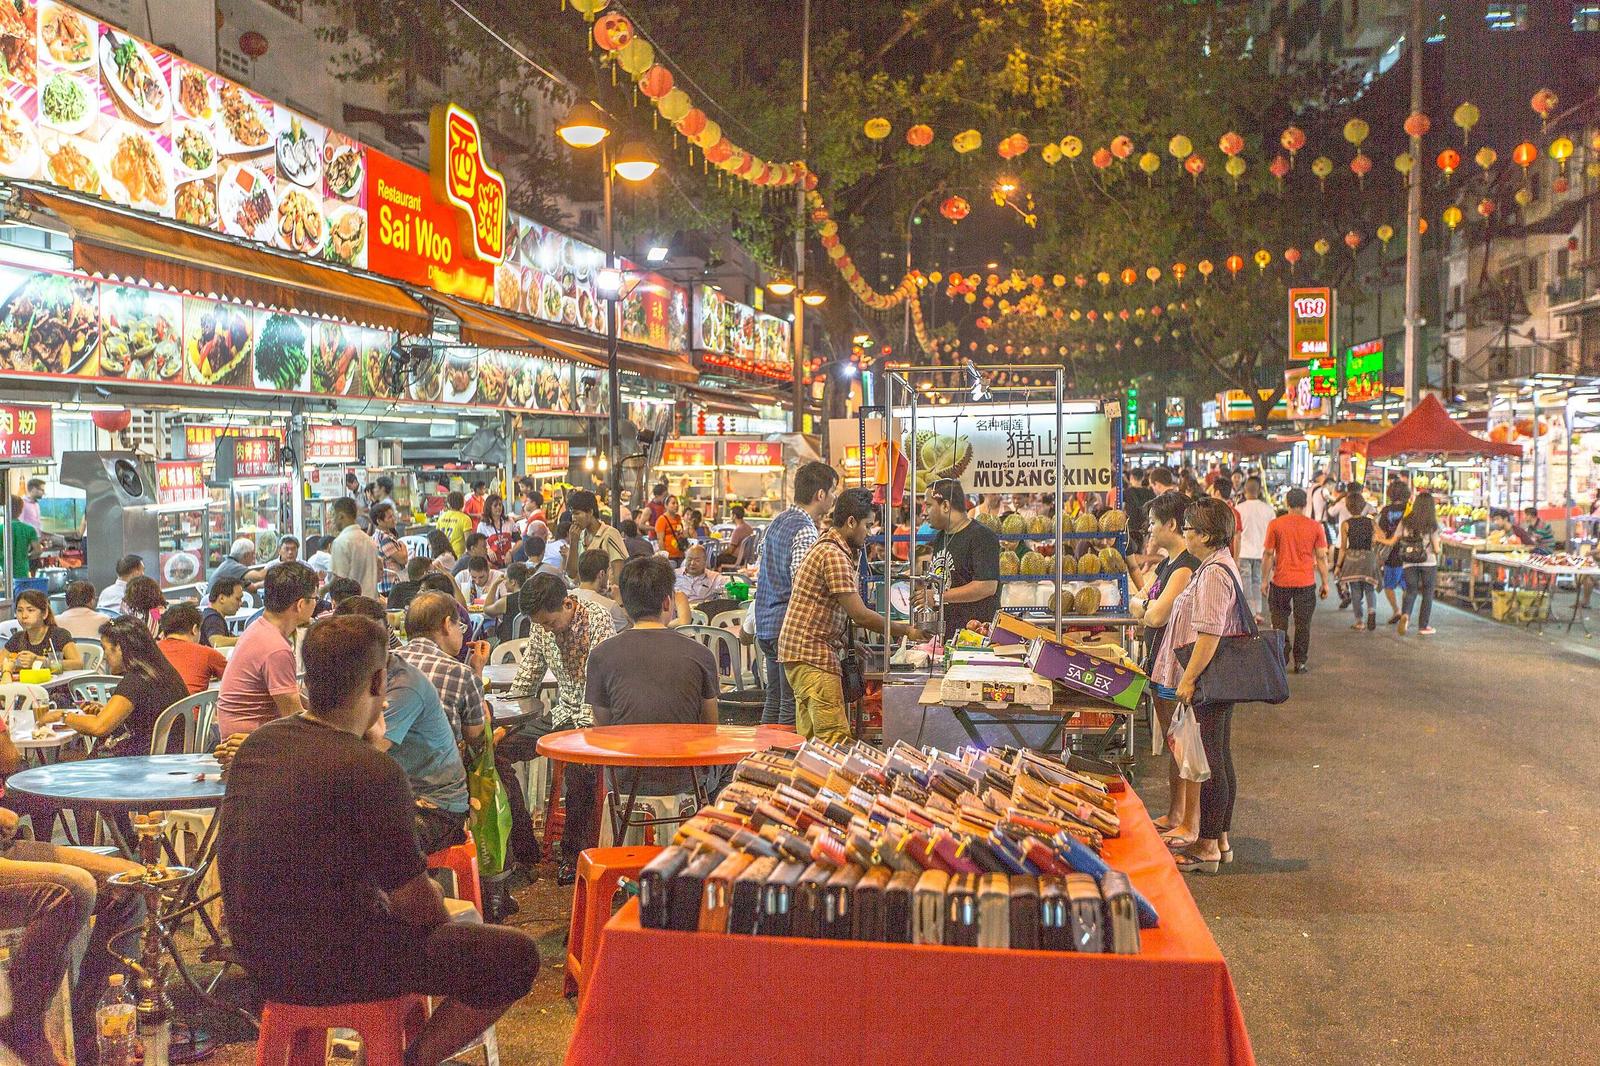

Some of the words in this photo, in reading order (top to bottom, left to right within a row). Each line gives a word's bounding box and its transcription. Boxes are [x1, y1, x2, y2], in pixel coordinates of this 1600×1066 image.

[378, 178, 421, 212] Restaurant
[380, 204, 410, 252] Sai
[415, 216, 452, 265] Woo
[1294, 297, 1327, 318] 168
[976, 418, 1024, 432] 名种榴莲
[12, 440, 31, 455] MEE
[1006, 430, 1094, 459] 猫山王
[734, 454, 772, 465] SATAY
[977, 460, 1015, 471] Malaysia
[1018, 459, 1038, 468] Local
[1041, 459, 1061, 468] Frui
[973, 468, 1057, 488] MUSANG
[1066, 666, 1114, 691] SAPEX
